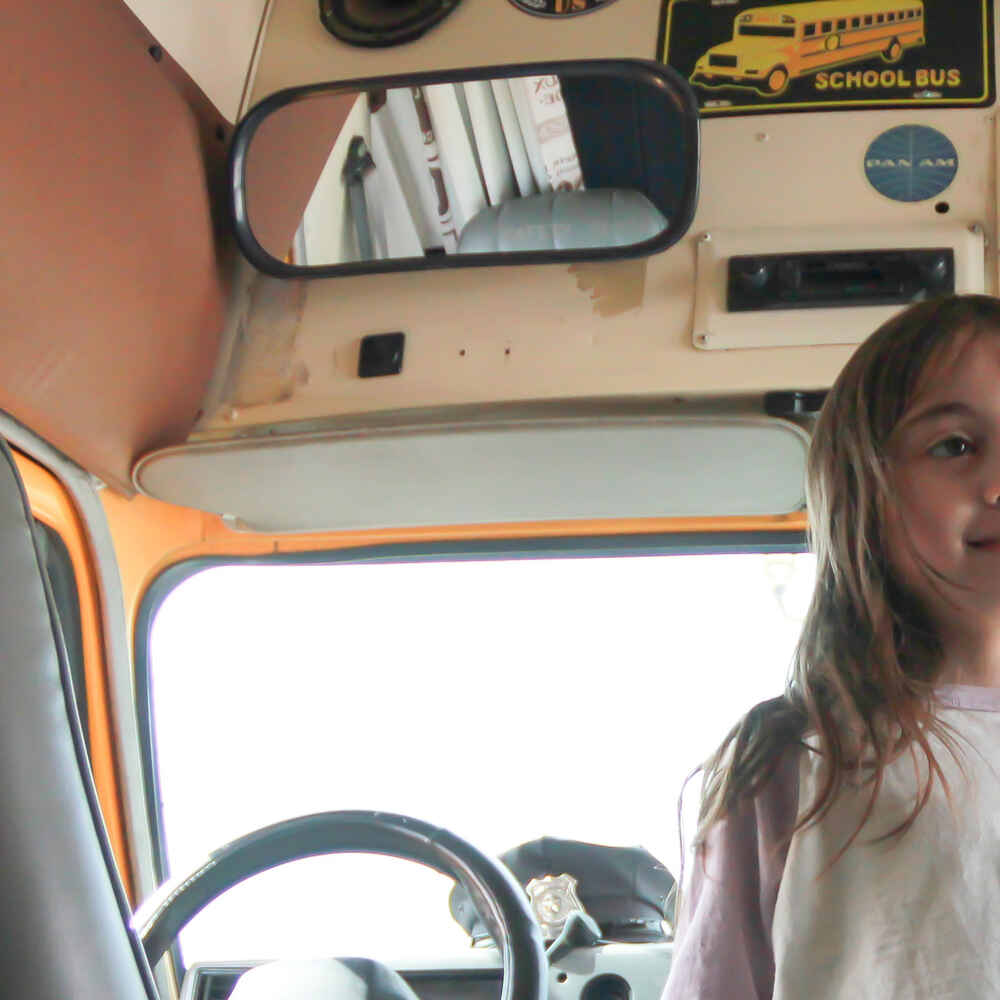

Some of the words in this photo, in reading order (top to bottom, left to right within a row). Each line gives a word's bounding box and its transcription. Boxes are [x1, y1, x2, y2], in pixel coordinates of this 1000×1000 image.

[815, 71, 911, 90] SCHOOL
[915, 68, 961, 87] BUS
[866, 158, 912, 168] PAN
[919, 157, 956, 168] AM
